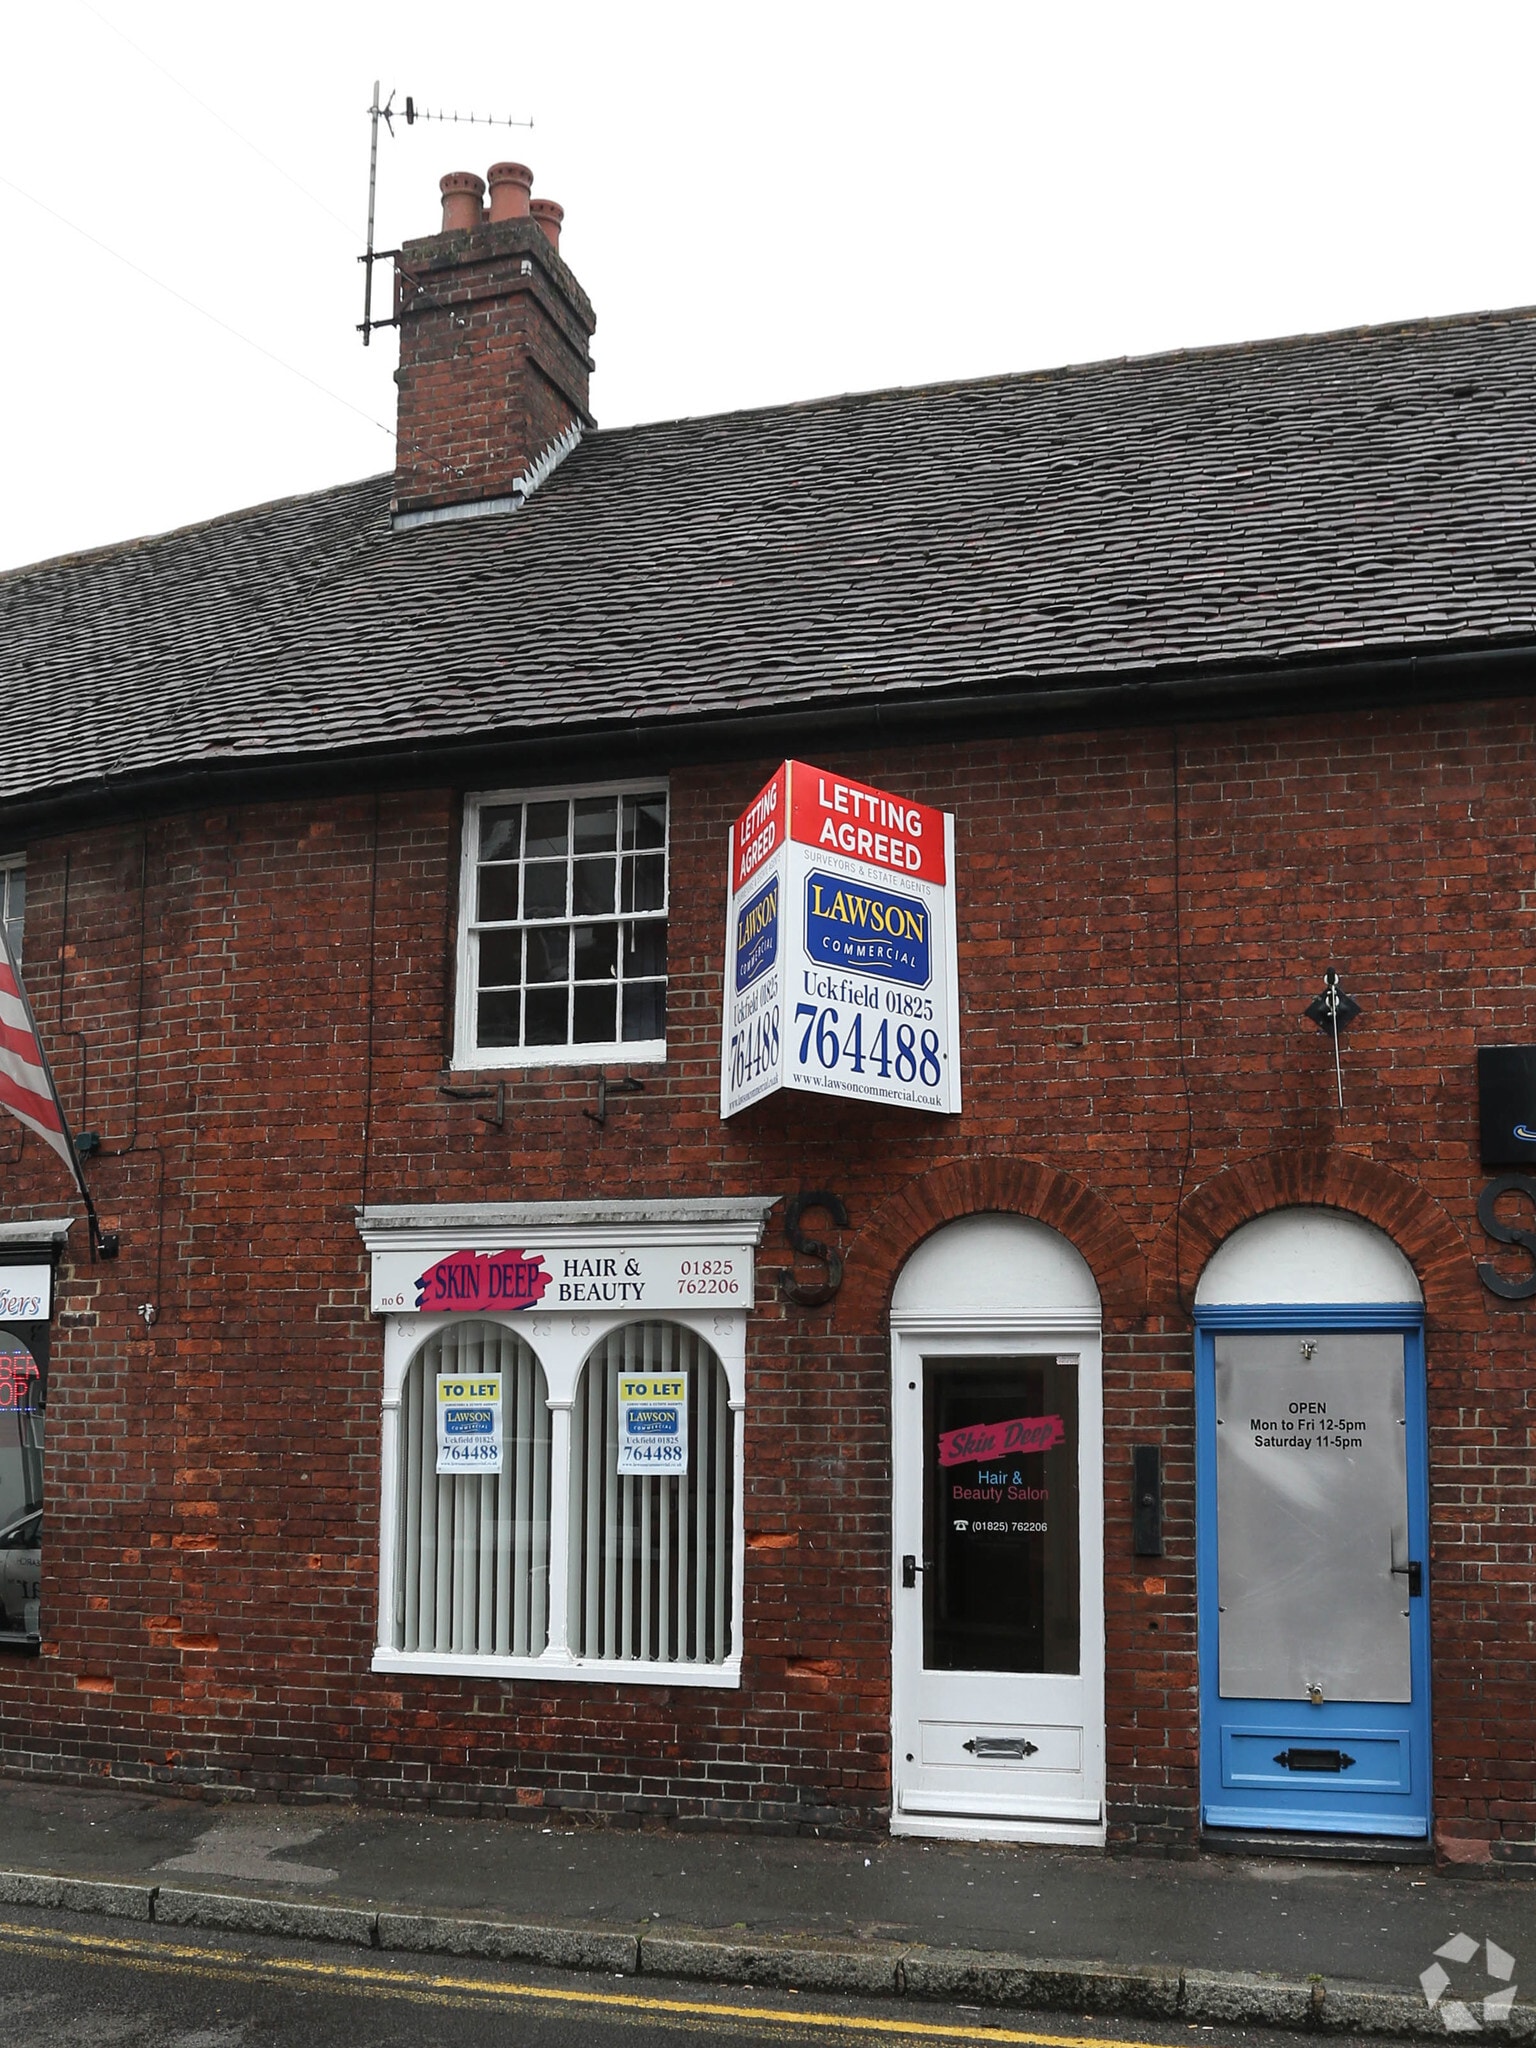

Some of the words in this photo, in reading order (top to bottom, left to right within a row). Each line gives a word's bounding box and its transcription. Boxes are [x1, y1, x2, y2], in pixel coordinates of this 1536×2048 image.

[740, 782, 777, 847] LETTING
[818, 778, 922, 836] LETTING
[739, 820, 776, 882] AGREED
[819, 817, 922, 871] AGREED
[803, 849, 856, 875] SURVEYORS
[858, 865, 866, 877] &
[867, 867, 898, 887] ESTATE
[900, 874, 931, 896] AGENTS
[737, 886, 779, 951] LAWSON
[811, 884, 925, 944] LAWSON
[739, 937, 773, 977] COMMERCIAL
[822, 935, 916, 969] COMMERCIAL
[759, 973, 779, 1009] 01825
[803, 970, 879, 1010] Uckfield
[886, 990, 934, 1022] 01825
[730, 1004, 780, 1092] 764488
[793, 1002, 941, 1088] 764488
[792, 1072, 942, 1108] www.lawsoncommercial.co.uk
[563, 1258, 618, 1277] HAIR
[624, 1258, 642, 1277] &
[681, 1260, 734, 1276] 01825
[434, 1263, 481, 1300] SKIN
[488, 1262, 540, 1299] DEEP
[677, 1278, 740, 1295] 762206
[395, 1292, 405, 1306] 6
[558, 1282, 647, 1302] BEAUTY
[443, 1384, 465, 1397] TO
[470, 1384, 497, 1396] LET
[624, 1383, 647, 1396] TO
[653, 1383, 682, 1396] LET
[447, 1412, 491, 1422] LAWSON
[629, 1411, 676, 1422] LAWSON
[1288, 1402, 1327, 1414] OPEN
[1250, 1418, 1278, 1431] Mon
[1281, 1420, 1295, 1431] to
[1298, 1418, 1315, 1431] Fri
[1319, 1419, 1367, 1434] 12-5pm
[445, 1436, 473, 1444] Uckfield
[474, 1436, 495, 1444] 01825
[626, 1436, 656, 1444] Uckfield
[657, 1436, 679, 1444] 01825
[948, 1432, 996, 1460] Skin
[1003, 1421, 1054, 1449] Deep
[1254, 1435, 1312, 1450] Saturday
[1316, 1436, 1363, 1450] 11-5pm
[442, 1445, 498, 1460] 764488
[624, 1445, 683, 1461] 764488
[978, 1470, 1009, 1485] Hair
[1012, 1470, 1023, 1485] &
[952, 1485, 1003, 1503] Beauty
[1007, 1485, 1049, 1500] Salon
[971, 1521, 1009, 1533] (01825)
[1011, 1521, 1048, 1532] 762206
